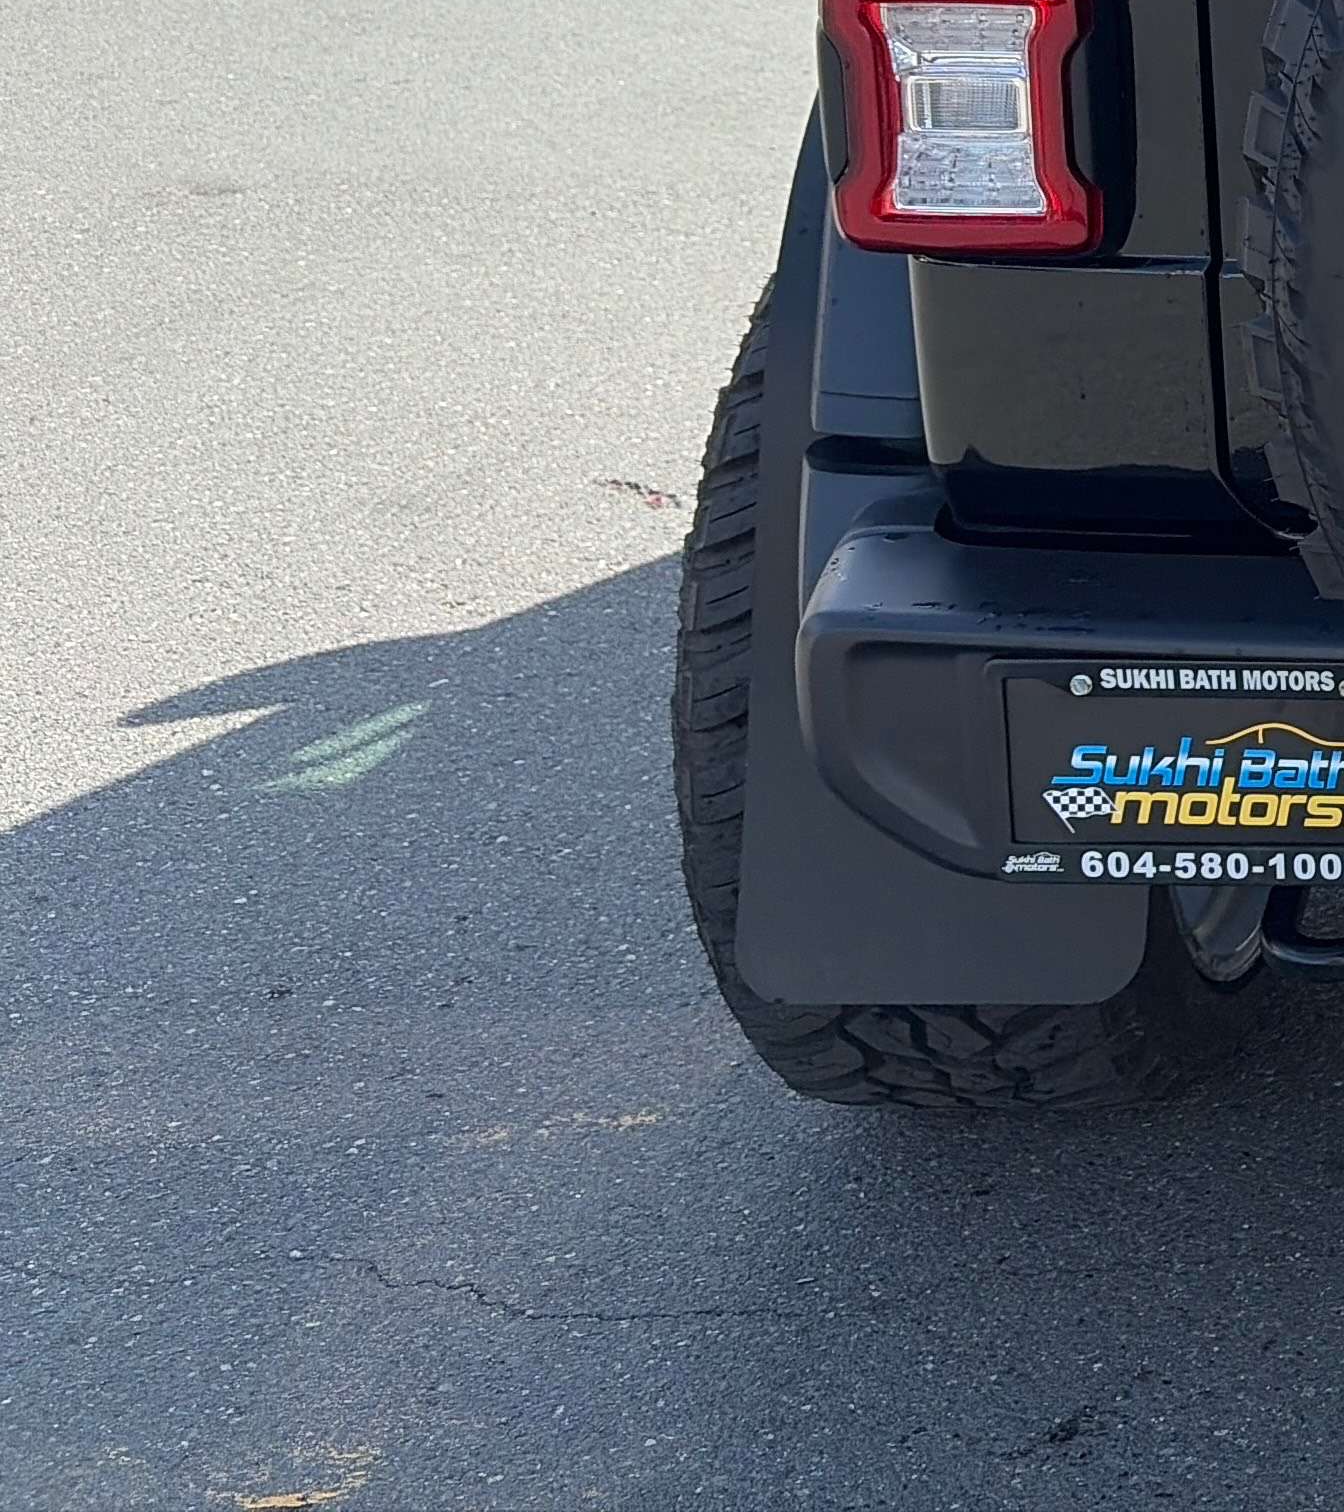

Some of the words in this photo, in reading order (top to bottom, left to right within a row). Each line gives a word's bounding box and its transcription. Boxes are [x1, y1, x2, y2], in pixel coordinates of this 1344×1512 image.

[1100, 668, 1175, 690] SUKHI
[1180, 669, 1237, 691] BATH
[1243, 670, 1335, 693] MOTORS
[1051, 737, 1225, 787] Sukhi
